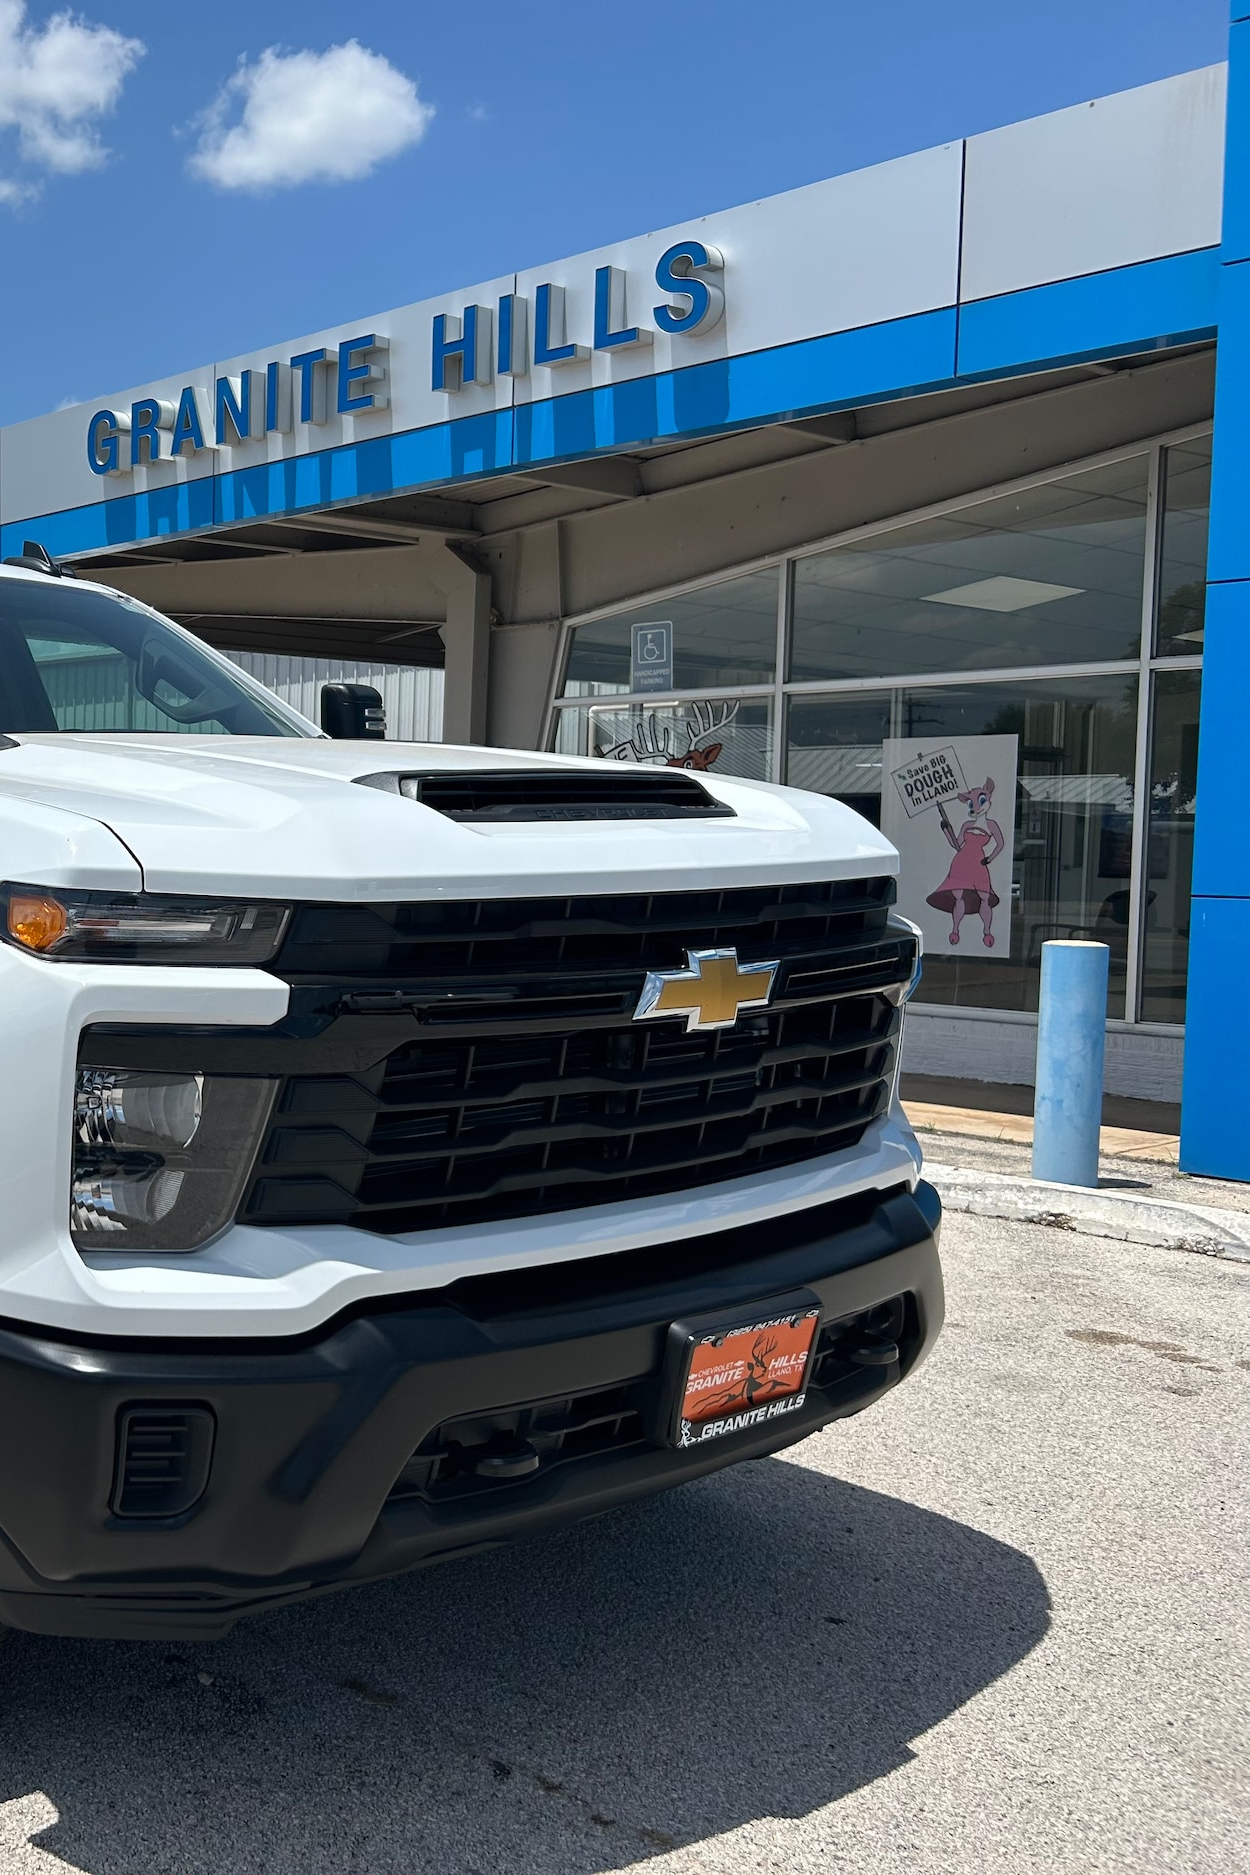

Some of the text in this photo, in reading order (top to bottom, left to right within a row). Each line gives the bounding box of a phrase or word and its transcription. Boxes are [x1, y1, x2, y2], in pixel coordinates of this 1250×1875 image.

[86, 239, 725, 477] GRANITE HILLS
[633, 668, 670, 678] HANDICAPPED
[640, 677, 664, 685] PARKING
[906, 754, 947, 779] Save BIG
[903, 763, 955, 798] DOUGH
[921, 778, 960, 802] LLANO!
[535, 807, 669, 819] CHEVROLET
[685, 1350, 809, 1395] GRANITE HILLS
[697, 1361, 735, 1378] CHEVROLET
[794, 1363, 804, 1373] TX
[701, 1393, 806, 1439] GRANITE HILLS
